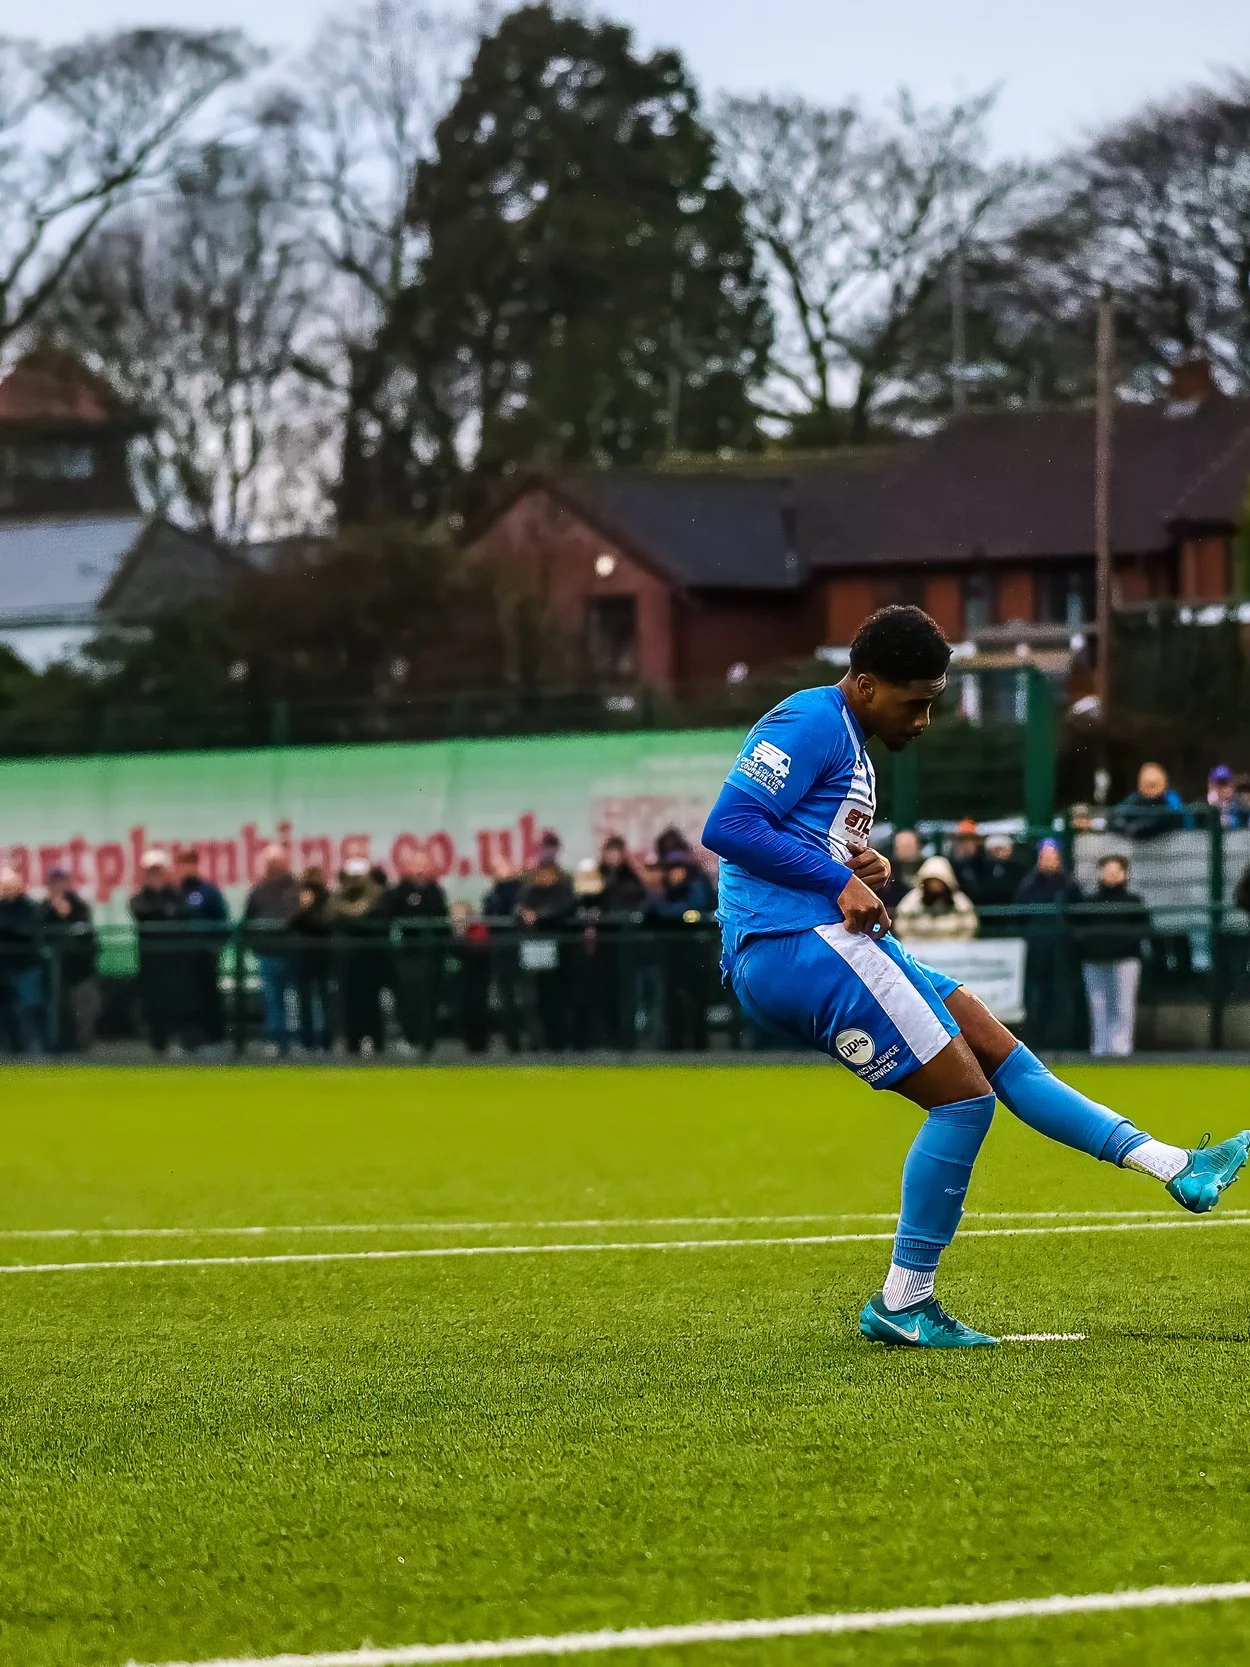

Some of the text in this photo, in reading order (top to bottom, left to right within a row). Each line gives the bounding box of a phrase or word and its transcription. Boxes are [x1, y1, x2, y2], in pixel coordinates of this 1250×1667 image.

[767, 779, 780, 791] LTD
[2, 811, 545, 903] artplmbingco.uk
[875, 1044, 900, 1066] ADVICE
[867, 1060, 898, 1082] SERVICES
